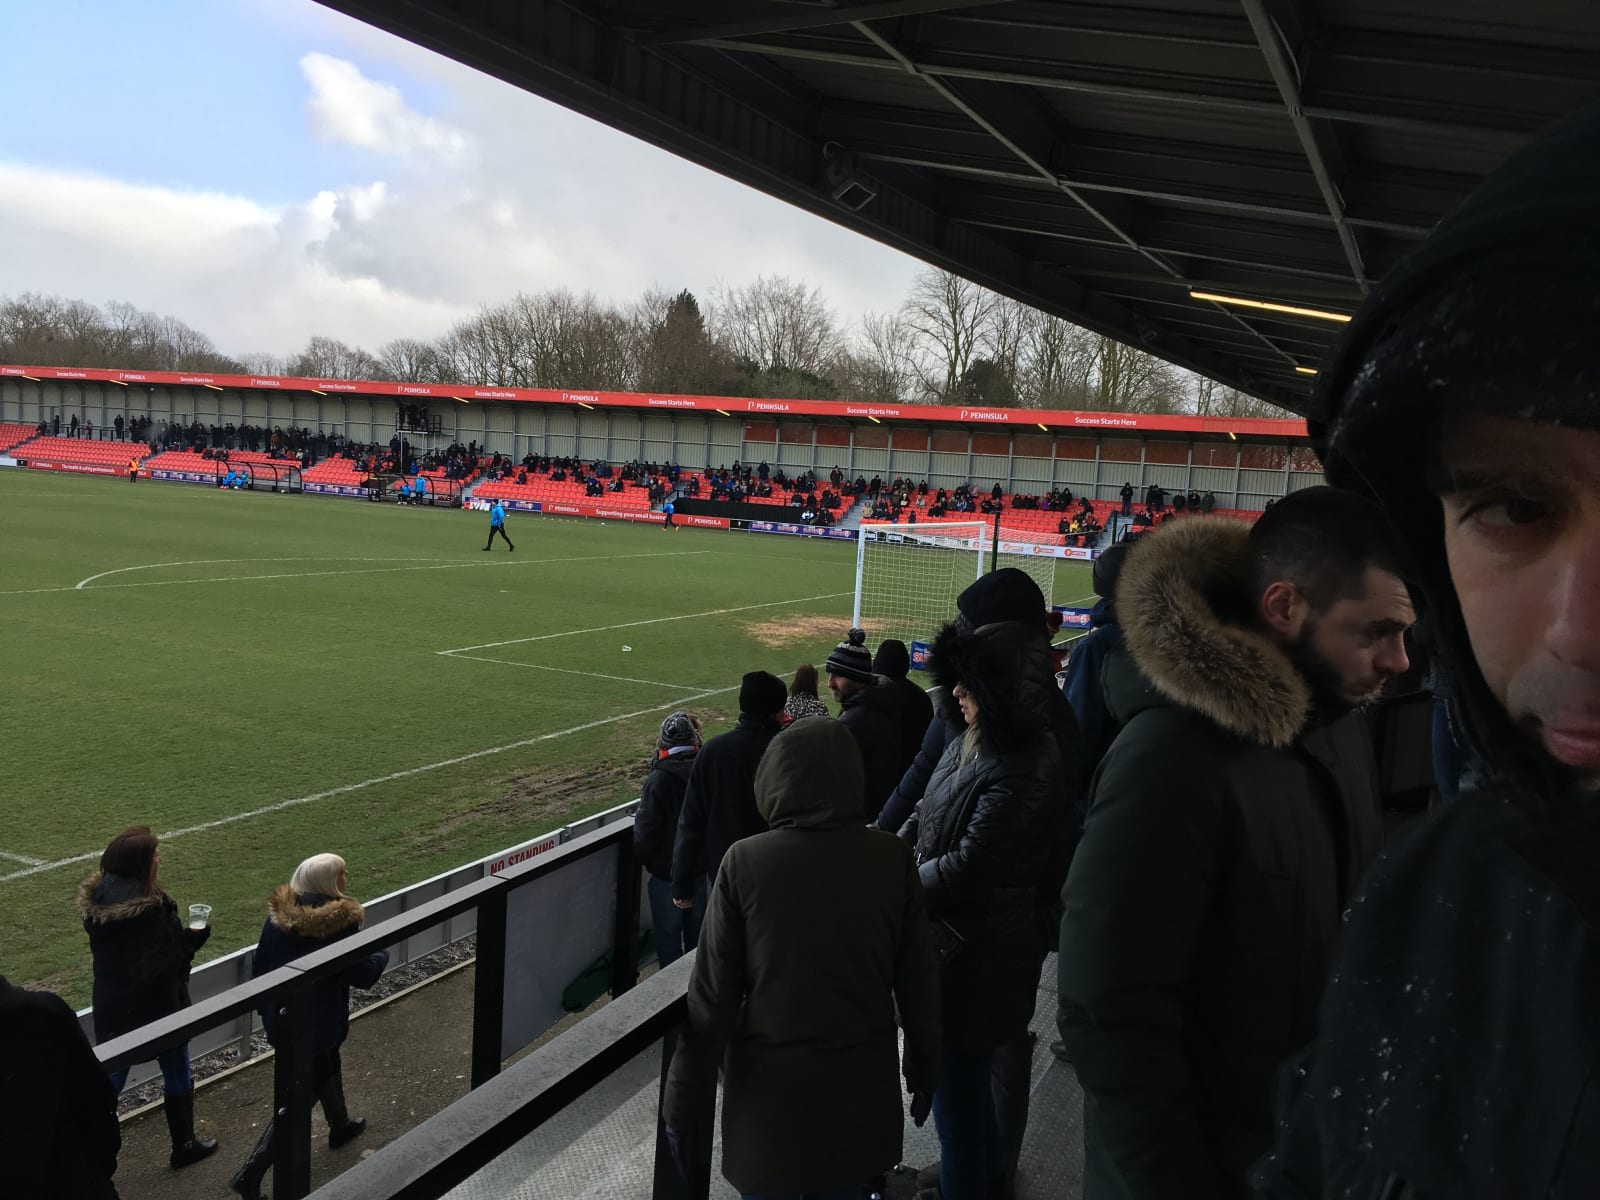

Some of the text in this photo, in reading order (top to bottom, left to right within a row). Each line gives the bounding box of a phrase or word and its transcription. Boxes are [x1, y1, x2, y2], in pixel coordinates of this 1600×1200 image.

[757, 403, 789, 411] PENINSULA
[971, 412, 1008, 421] PENINSULA
[1075, 416, 1137, 426] Success Starts Here
[490, 839, 555, 875] NO STANDING
